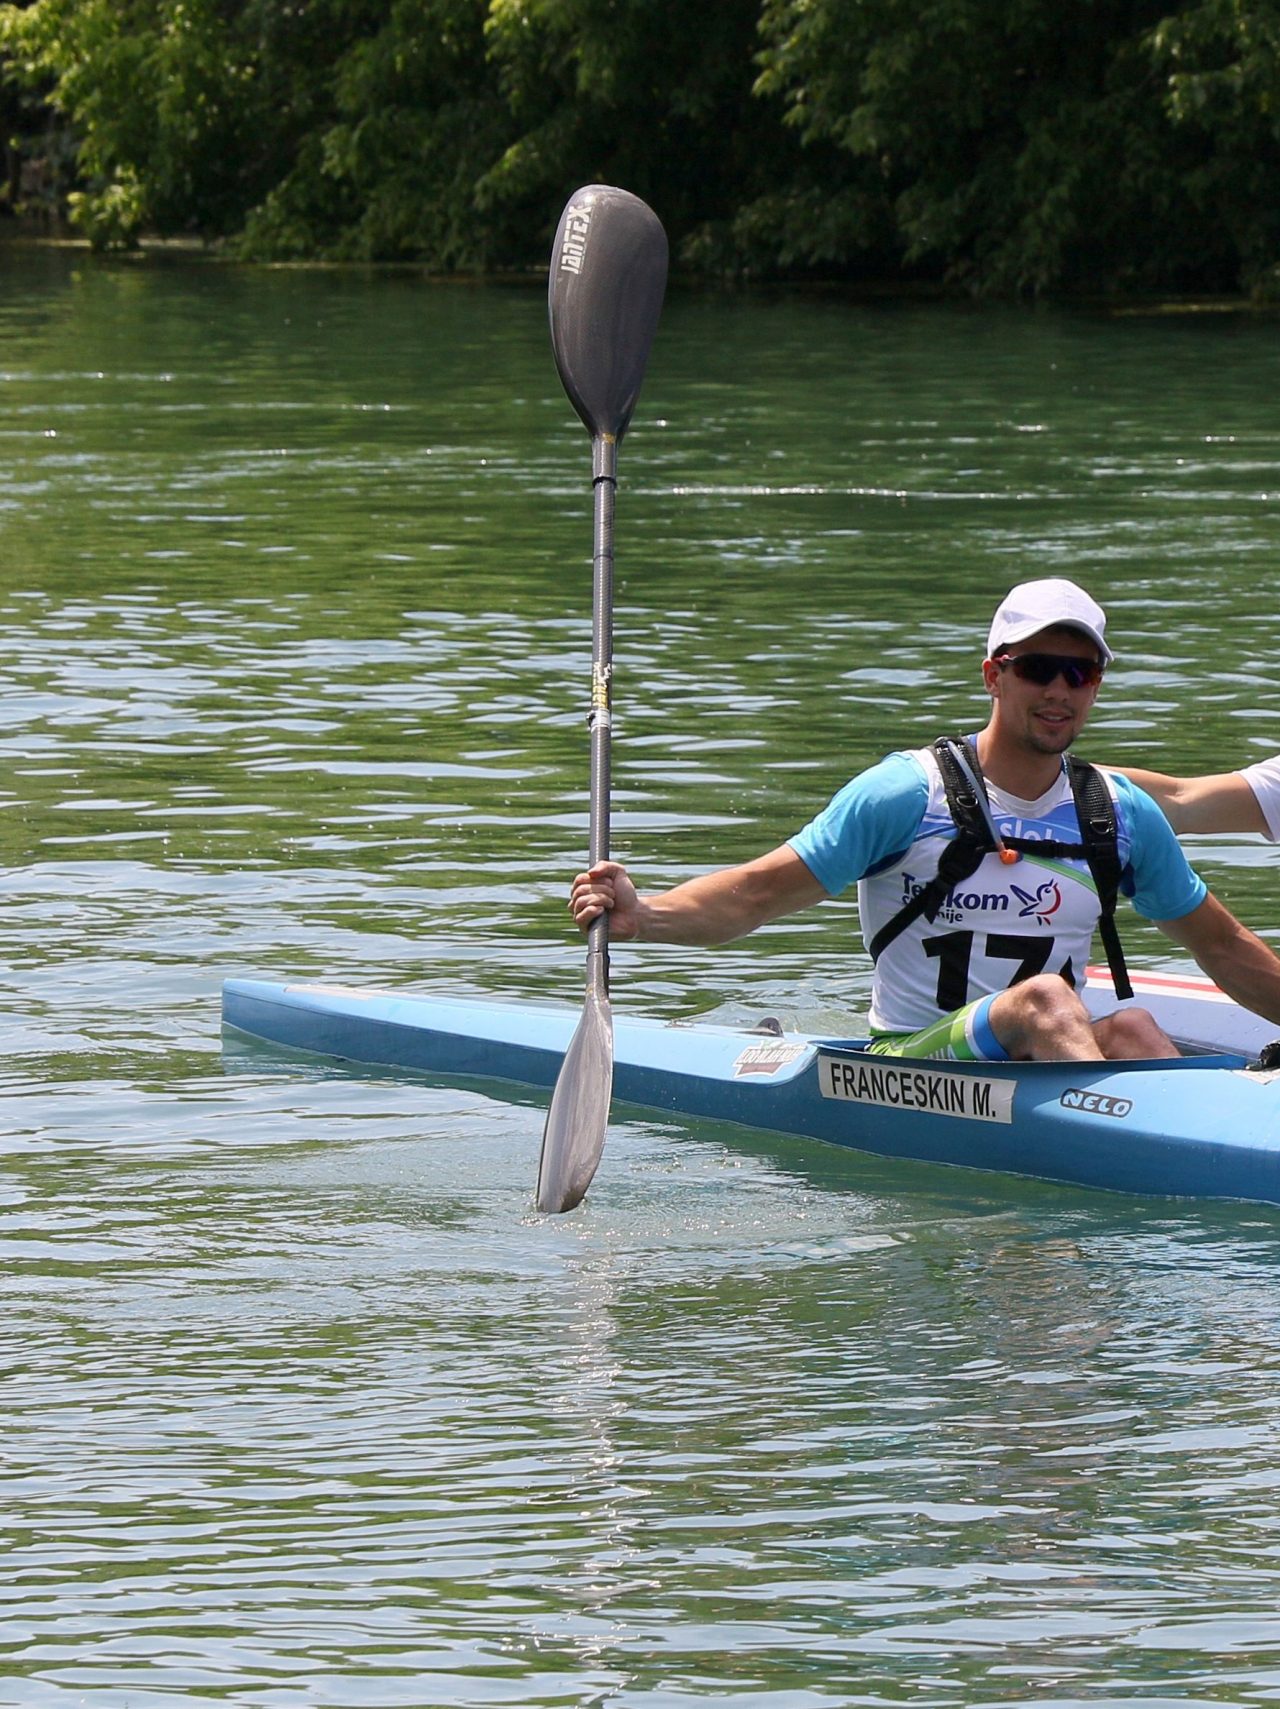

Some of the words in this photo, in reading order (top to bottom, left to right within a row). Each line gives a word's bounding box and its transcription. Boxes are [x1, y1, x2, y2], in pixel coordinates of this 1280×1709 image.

[830, 1062, 965, 1114] FRANCESKIN
[973, 1082, 996, 1118] M.
[1062, 1092, 1131, 1116] NELO
